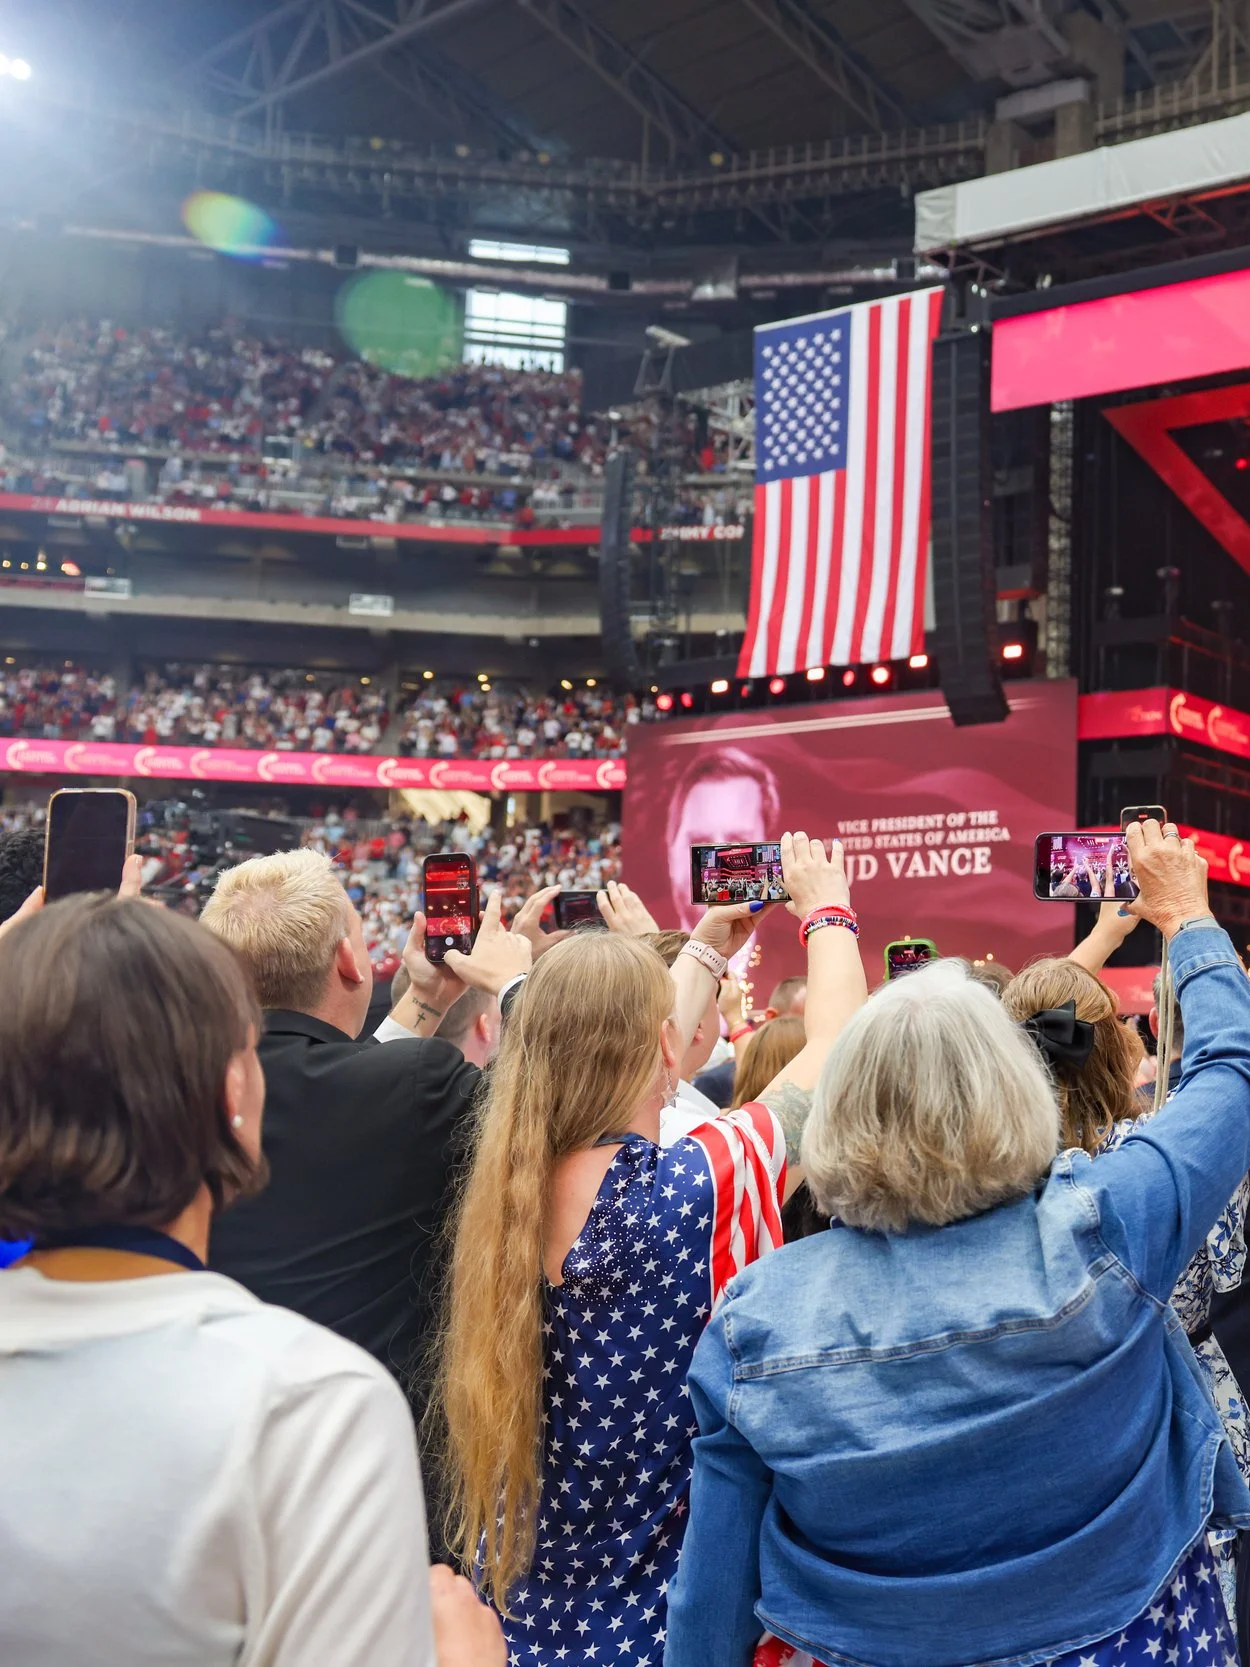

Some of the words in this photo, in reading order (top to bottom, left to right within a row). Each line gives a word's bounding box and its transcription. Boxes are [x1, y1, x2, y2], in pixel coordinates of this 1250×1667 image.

[129, 502, 200, 521] WILSON
[837, 819, 869, 834] VICE
[871, 813, 946, 832] PRESIDENT
[946, 812, 967, 827] OF
[967, 810, 999, 826] THE
[874, 832, 924, 849] STATES
[924, 830, 945, 847] OF
[946, 827, 1011, 845] AMERICA
[886, 846, 992, 880] VANCE
